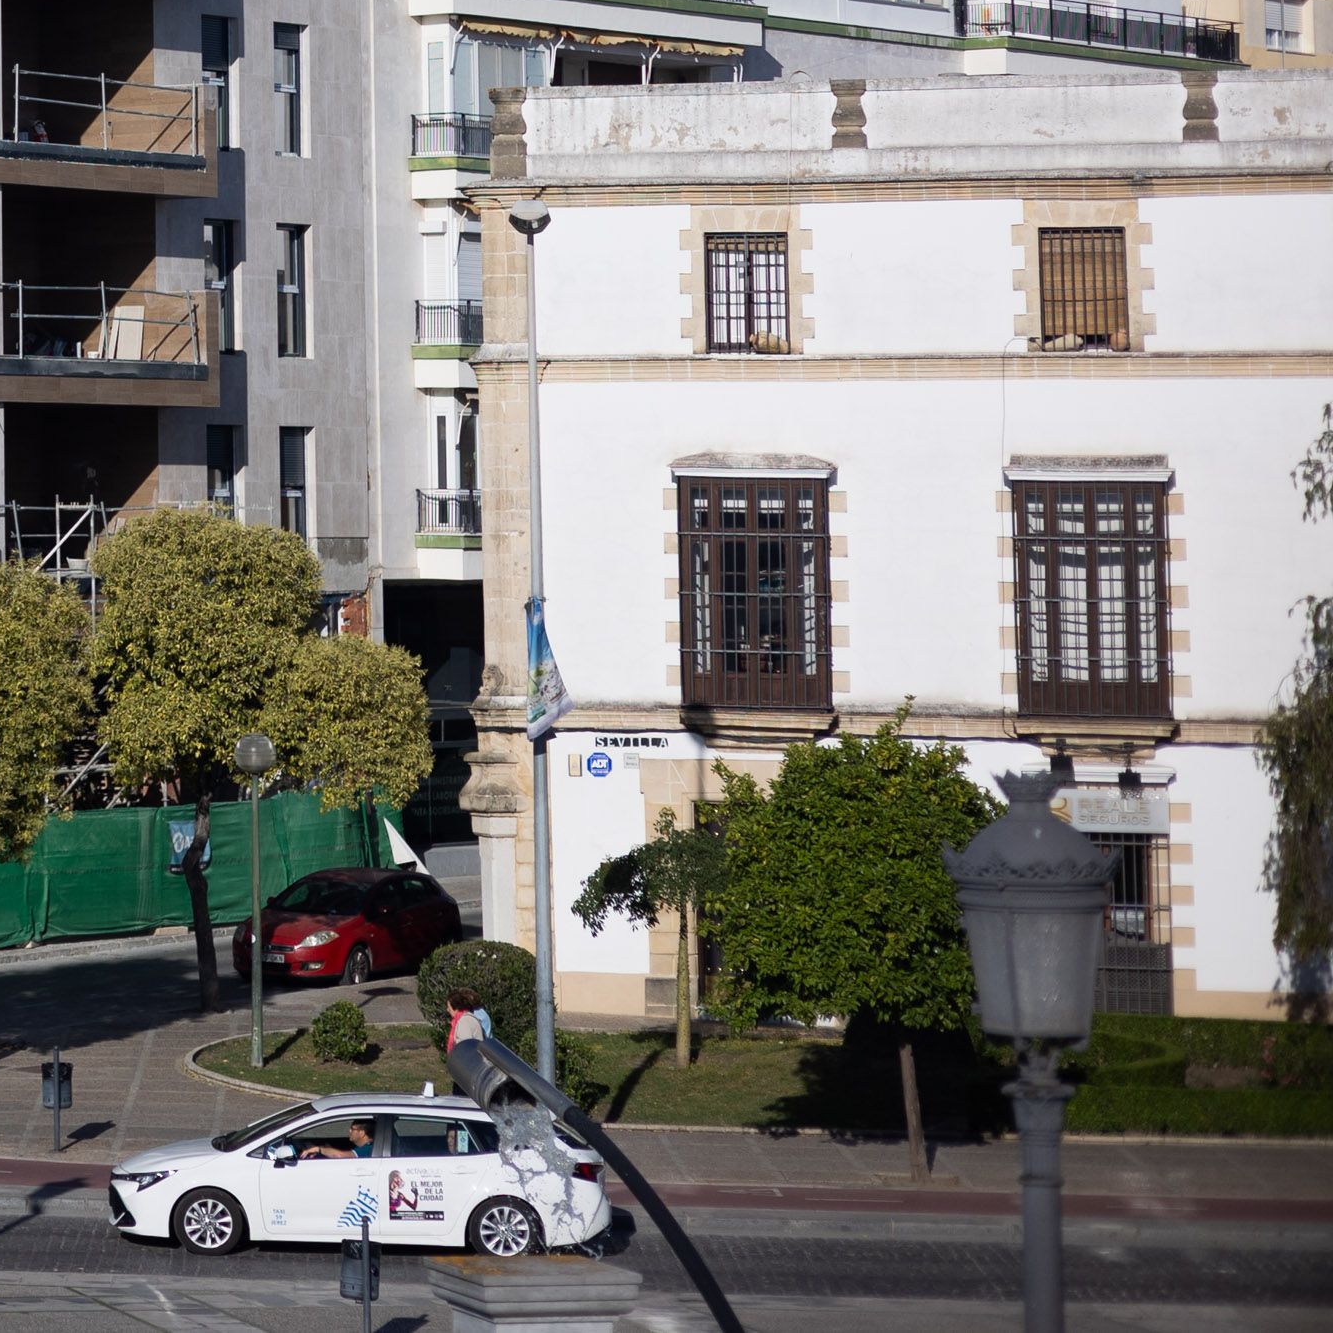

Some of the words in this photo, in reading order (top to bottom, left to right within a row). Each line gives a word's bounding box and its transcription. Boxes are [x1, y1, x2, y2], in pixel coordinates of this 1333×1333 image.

[595, 737, 669, 747] SEVILLA
[592, 759, 608, 769] ADT
[1077, 798, 1151, 814] REALE
[1077, 814, 1151, 826] SEGUROS
